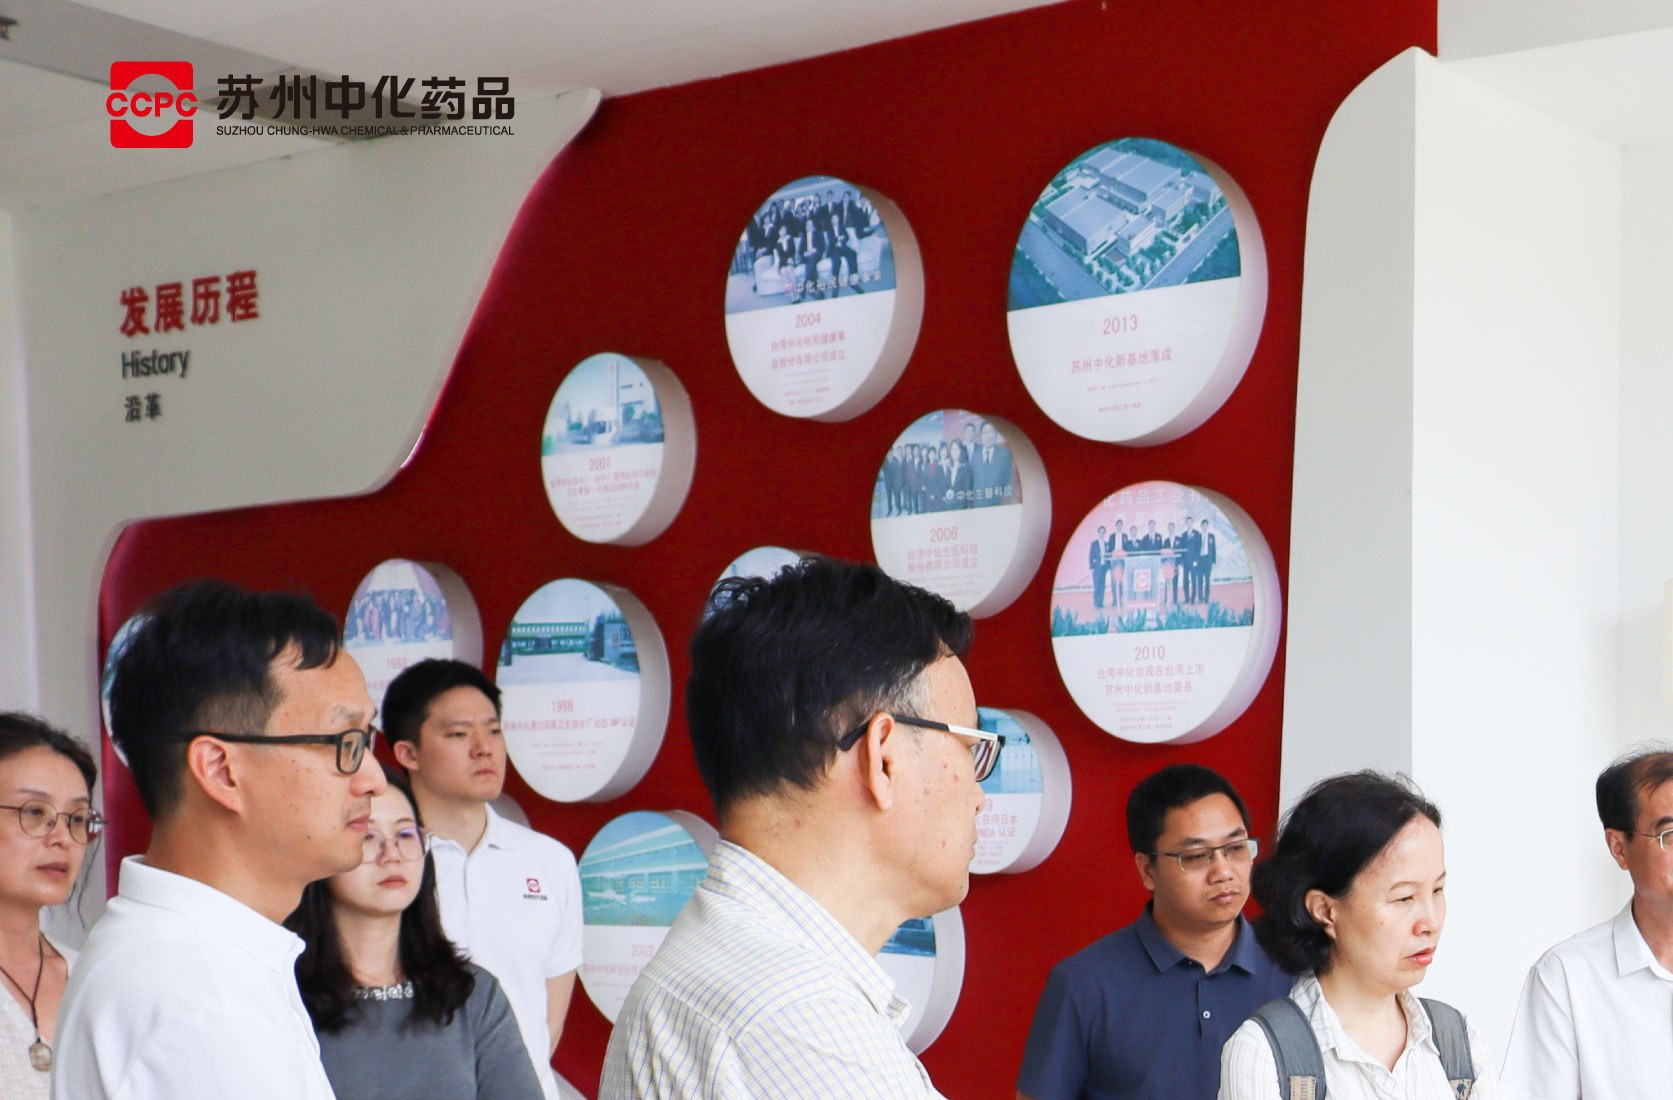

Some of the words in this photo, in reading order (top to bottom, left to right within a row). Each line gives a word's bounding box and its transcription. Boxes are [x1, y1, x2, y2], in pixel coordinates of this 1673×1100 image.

[120, 270, 259, 338] 发展历程
[795, 311, 821, 328] 2004
[1103, 314, 1138, 335] 2013
[121, 350, 189, 379] History
[125, 392, 161, 422] 沿革
[930, 526, 958, 542] 2006
[1134, 645, 1166, 661] 2010
[552, 699, 574, 713] 1998
